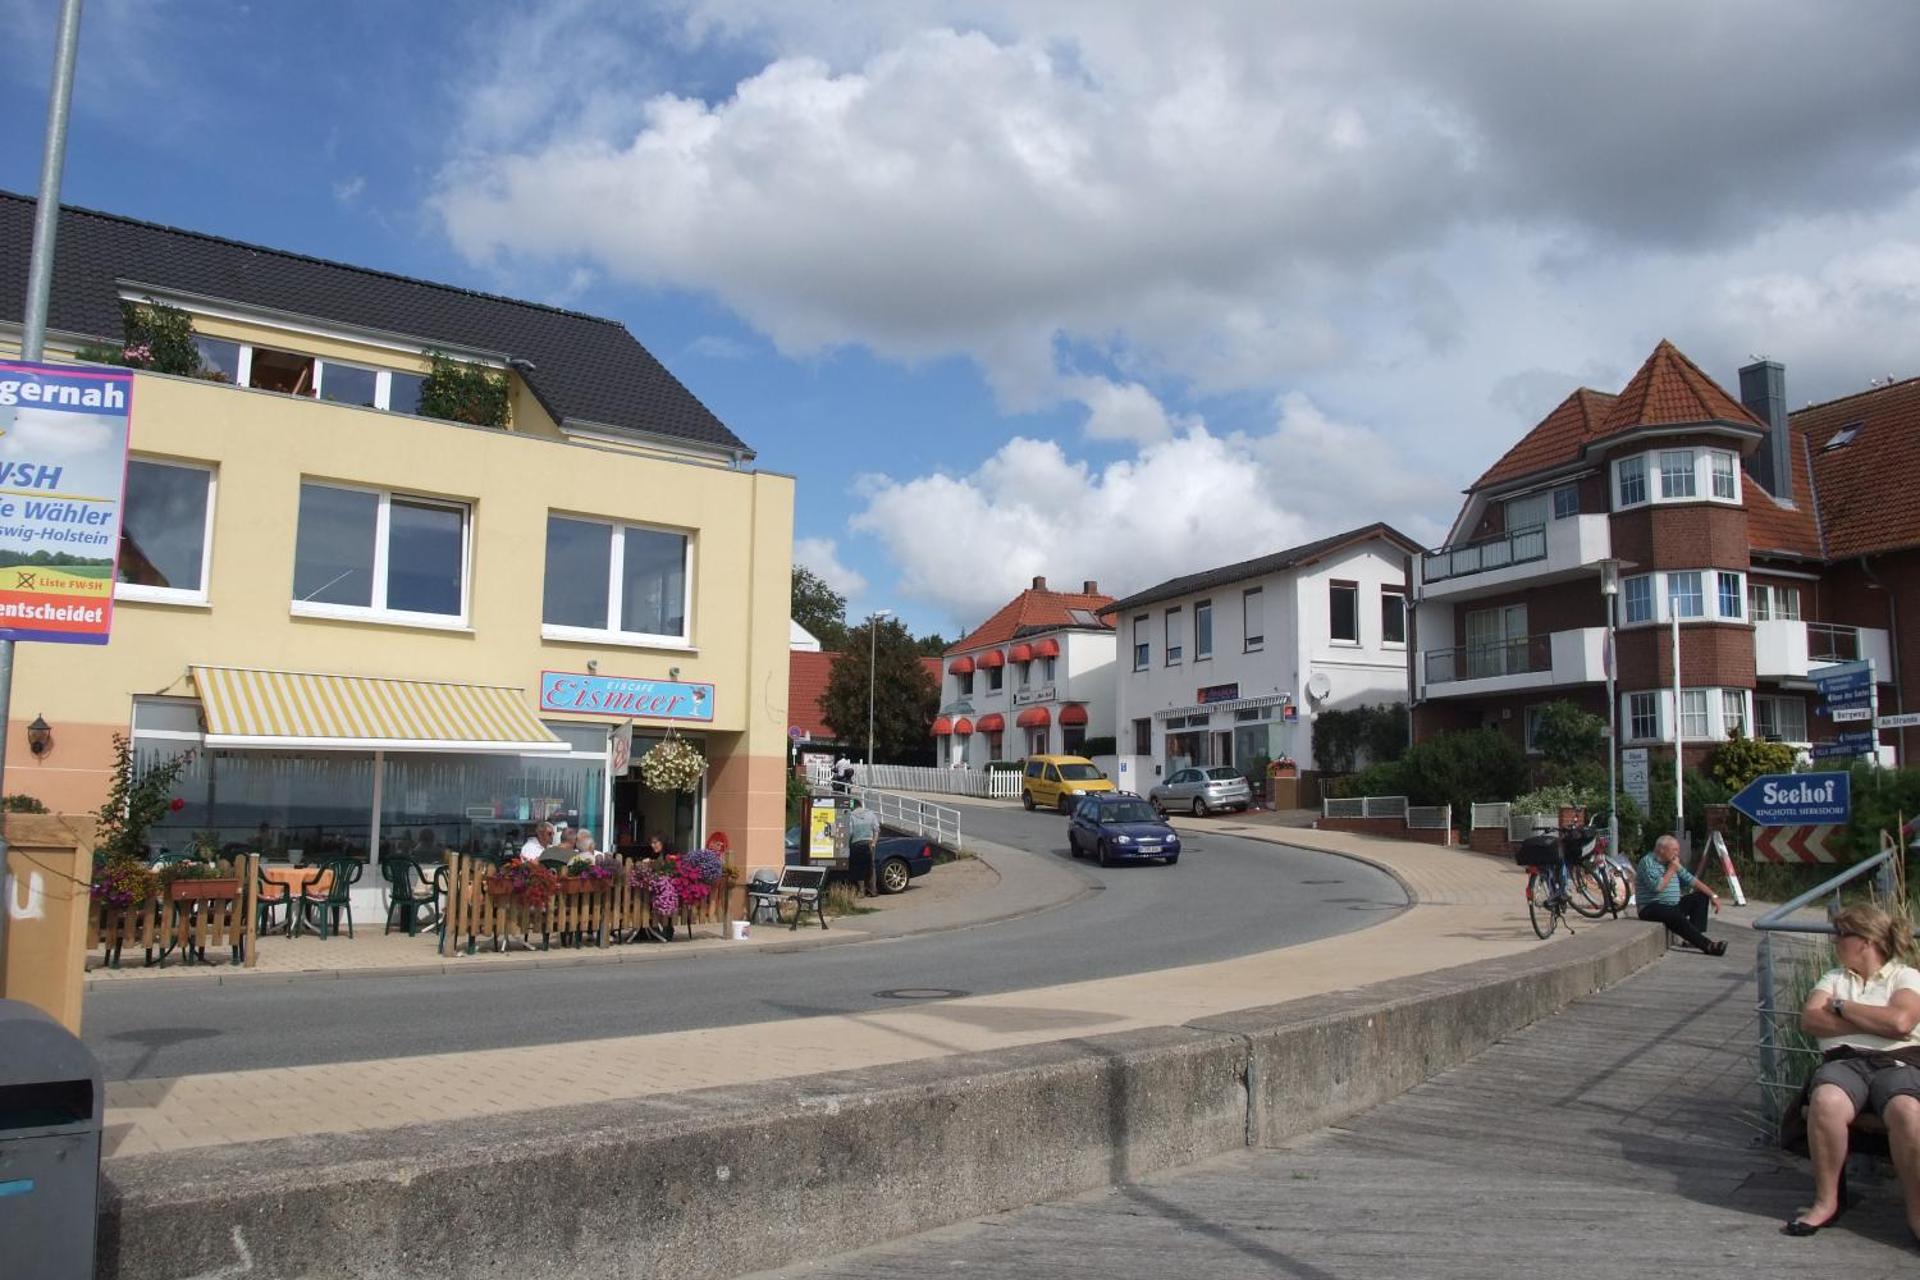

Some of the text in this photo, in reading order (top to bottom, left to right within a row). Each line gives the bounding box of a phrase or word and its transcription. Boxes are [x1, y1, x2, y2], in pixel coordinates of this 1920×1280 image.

[0, 380, 124, 409] gernah
[24, 500, 112, 526] Wähler
[40, 578, 65, 588] Liste
[546, 679, 686, 714] Eismeer
[1763, 780, 1835, 805] Seehof
[1756, 808, 1797, 817] RINGHOTEL
